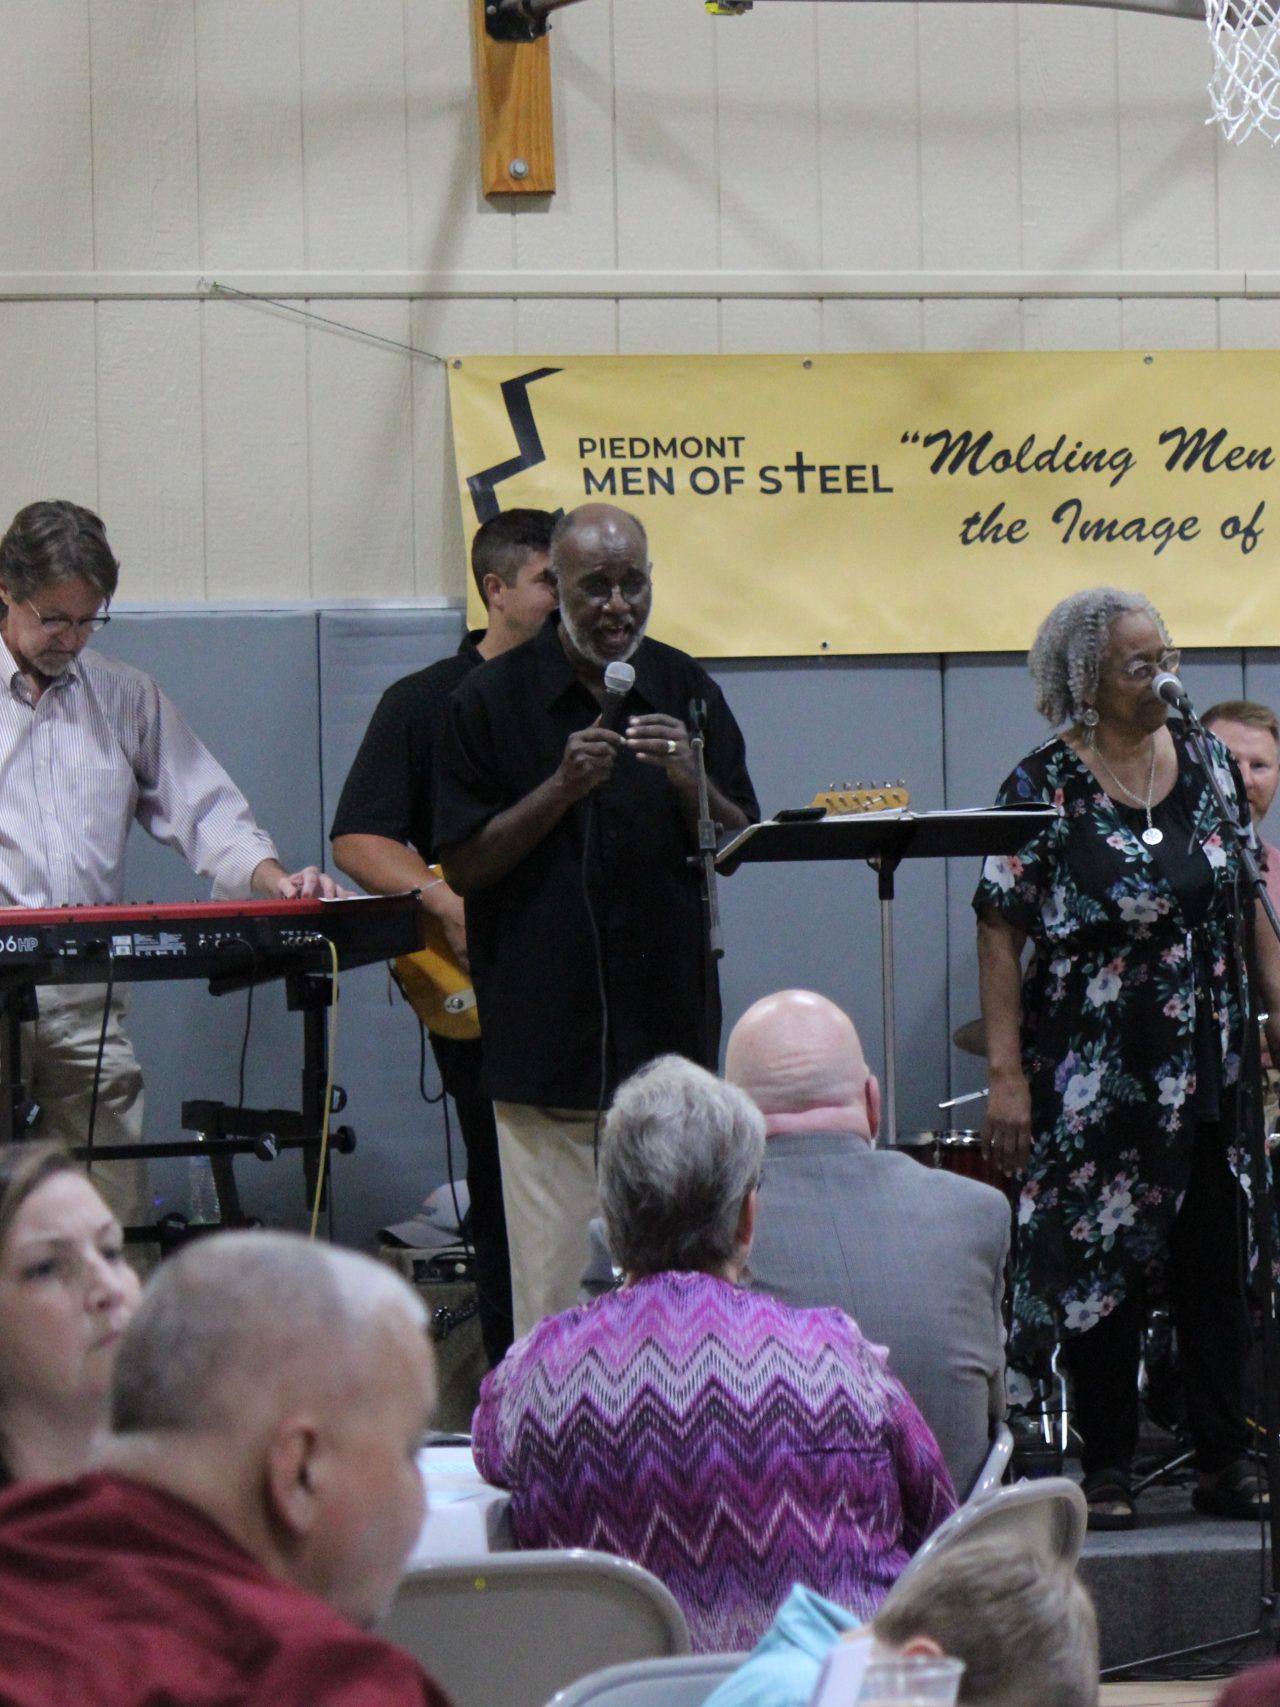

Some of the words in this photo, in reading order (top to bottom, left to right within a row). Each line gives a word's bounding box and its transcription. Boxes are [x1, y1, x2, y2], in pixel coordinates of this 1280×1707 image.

[578, 436, 745, 459] PIEDMONT
[901, 429, 1136, 487] “Molding
[1159, 426, 1275, 473] Men
[583, 467, 675, 496] MEN
[689, 466, 745, 496] OF
[759, 451, 894, 495] STEEL
[960, 501, 1030, 546] the
[1052, 498, 1201, 555] Image
[1220, 501, 1264, 554] of
